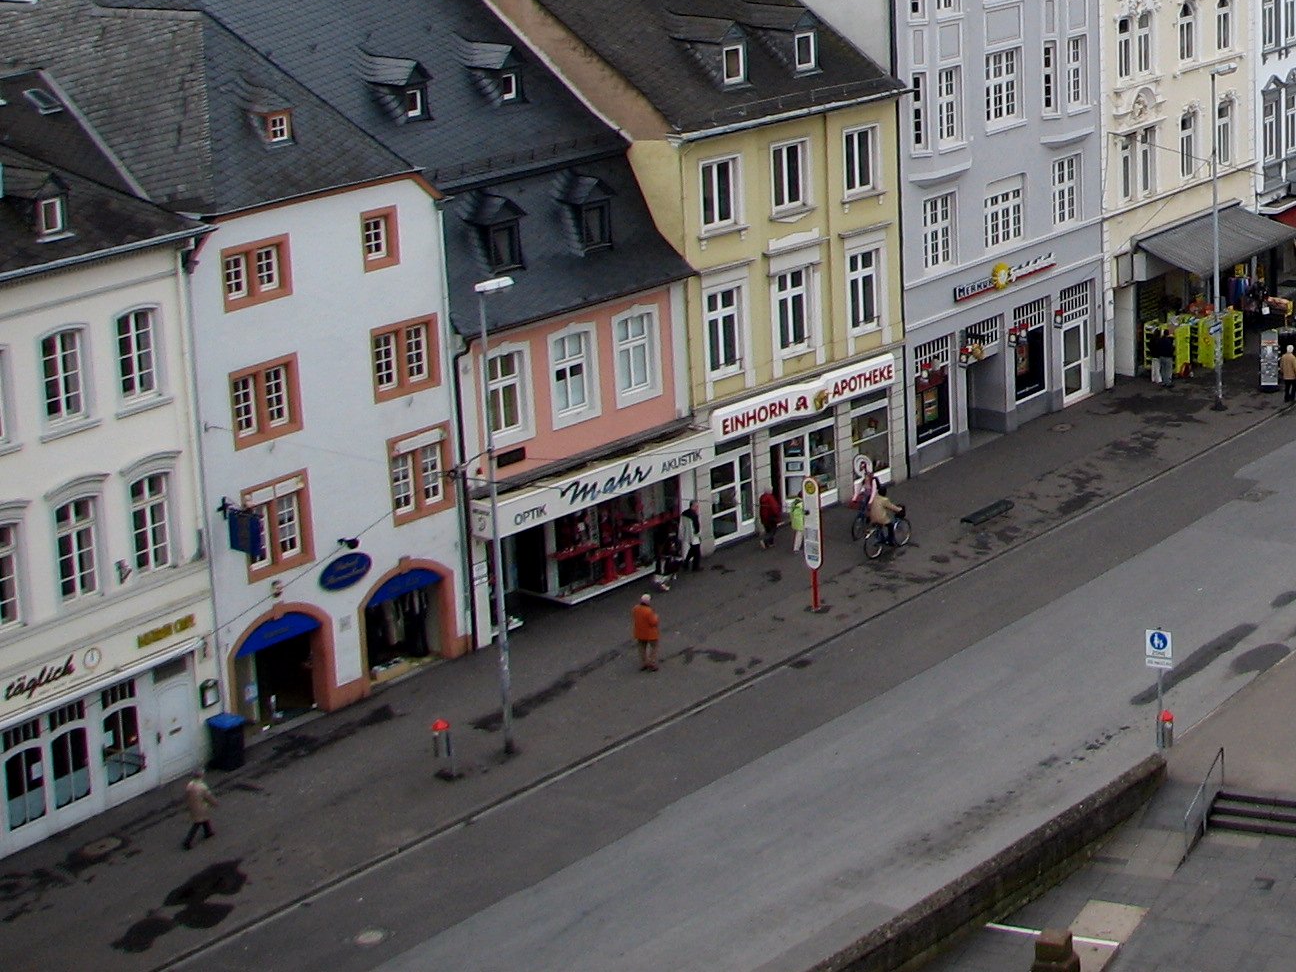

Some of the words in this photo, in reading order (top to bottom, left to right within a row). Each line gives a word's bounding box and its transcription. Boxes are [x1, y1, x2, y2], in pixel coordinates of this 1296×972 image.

[722, 397, 789, 436] EINHORN
[832, 363, 893, 398] APOTHEKE
[514, 504, 547, 526] OPTIK
[660, 449, 703, 475] AKUSTIK
[5, 654, 76, 701] täglich
